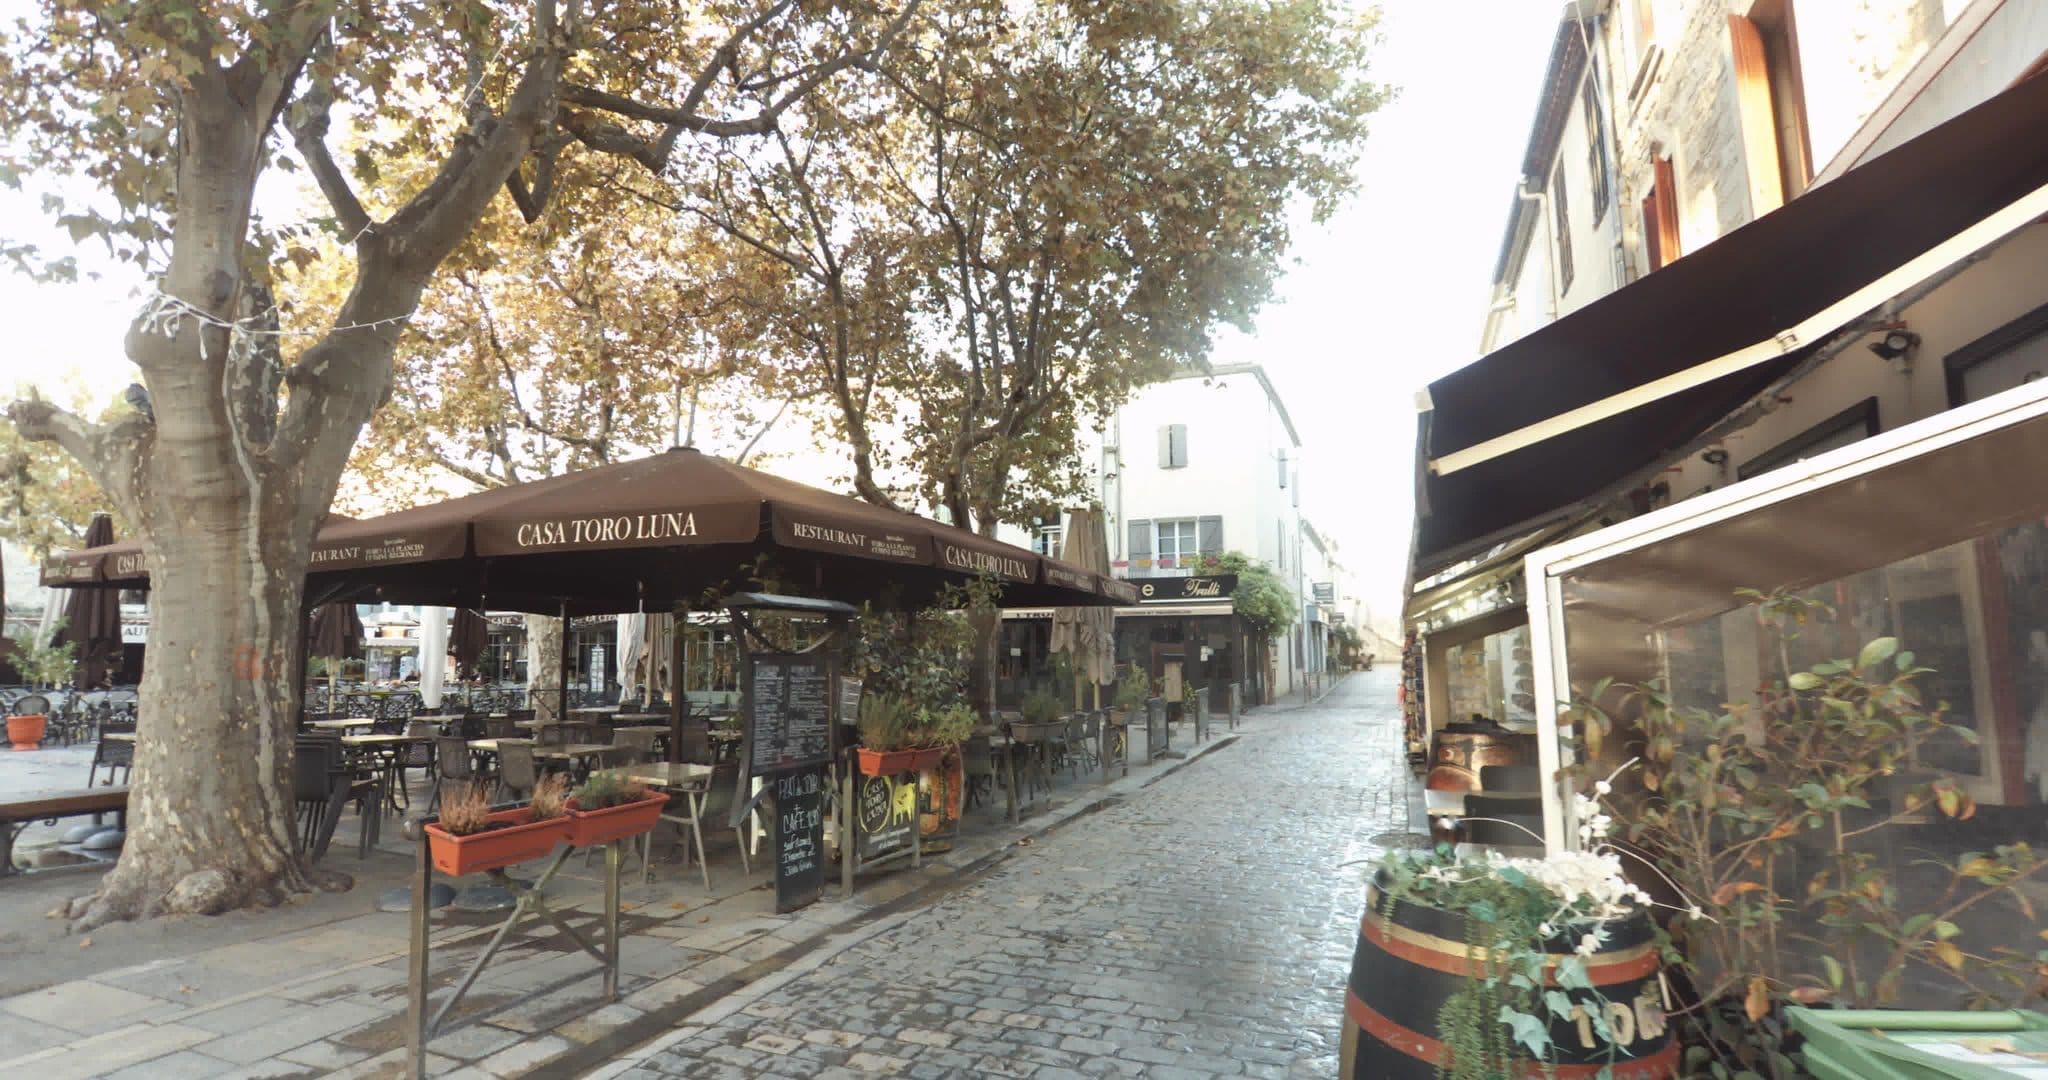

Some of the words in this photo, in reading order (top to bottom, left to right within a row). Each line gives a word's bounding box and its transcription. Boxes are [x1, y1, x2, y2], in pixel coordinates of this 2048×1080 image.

[516, 522, 567, 547] CASA
[571, 516, 631, 543] TORO
[635, 512, 697, 539] LUNA
[793, 522, 867, 547] RESTAURANT
[946, 545, 974, 568] CASA
[974, 554, 1003, 575] TORO
[1003, 558, 1028, 579] LUNA
